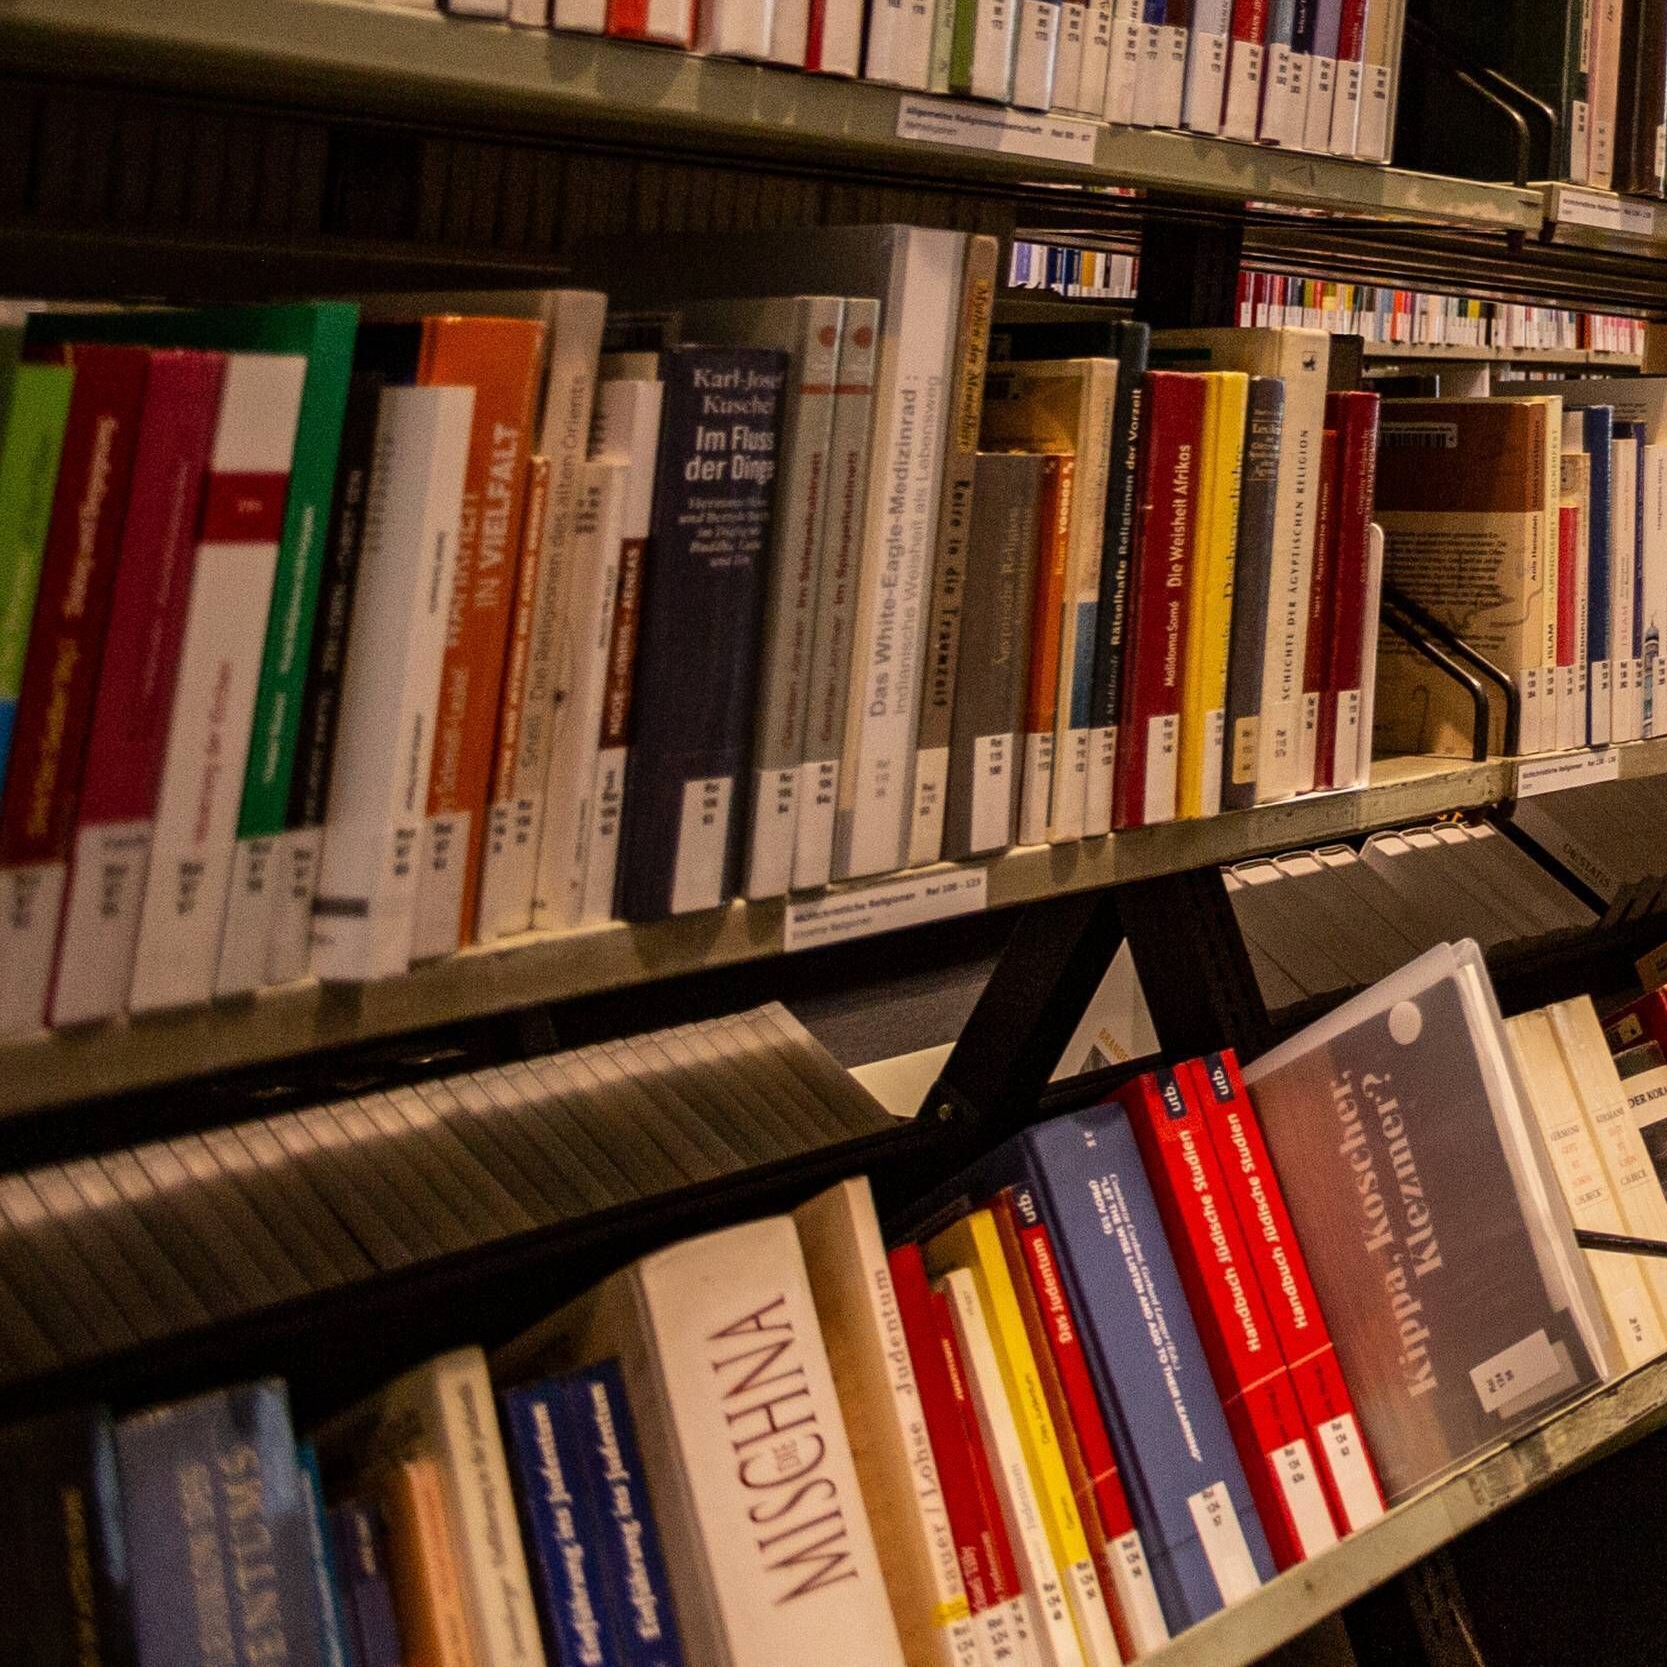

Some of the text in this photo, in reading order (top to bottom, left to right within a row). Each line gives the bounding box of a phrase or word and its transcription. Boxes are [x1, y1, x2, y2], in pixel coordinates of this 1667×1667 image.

[694, 421, 775, 453] Im Fluss
[915, 374, 941, 480] Lebensweg
[1128, 387, 1142, 439] Vorzeit
[682, 451, 775, 487] der Dinge
[1125, 444, 1137, 468] der
[1296, 429, 1310, 493] RELIGION
[912, 486, 927, 513] als
[1118, 473, 1135, 554] Religionen
[870, 387, 920, 717] Das White-Eagle-Medizinrad
[904, 518, 925, 601] Weisheit
[1163, 443, 1191, 687] Malidoma Somé Die Weisheit Afrikas
[1286, 500, 1304, 593] ÄGYPTISCHEN
[473, 574, 502, 610] IN
[932, 478, 971, 708] Reise in die Traumzeit
[1111, 559, 1127, 645] Rätselhafte
[1286, 600, 1297, 625] DER
[868, 888, 916, 909] Religionen
[1161, 1082, 1183, 1112] utb.
[1209, 1065, 1229, 1096] utb.
[1594, 1105, 1625, 1124] KERMANI
[1627, 1092, 1646, 1108] DER
[1358, 1068, 1446, 1277] Klezmer?
[1548, 1123, 1579, 1142] KERMANI
[1014, 1189, 1037, 1224] utb.
[1086, 1178, 1108, 1214] (PROV
[1223, 1112, 1311, 1329] Handbuch Jüdische Studien
[1320, 1068, 1442, 1398] Kippa, Koscher,
[1176, 1129, 1262, 1353] Handbuch Jüdische Studien
[1027, 1236, 1073, 1344] Das Judentum
[874, 1267, 911, 1396] Judentum
[1106, 1202, 1122, 1224] THE
[1114, 1225, 1132, 1254] WISE
[1123, 1255, 1145, 1293] LISTEN
[1137, 1294, 1154, 1320] AND
[1146, 1319, 1163, 1346] ADD
[1160, 1364, 1180, 1398] THEIR
[1171, 1398, 1204, 1462] LEARNING"
[527, 1399, 572, 1506] Judentum
[584, 1380, 629, 1482] Judentum
[705, 1293, 860, 1608] MISCHNA
[771, 1437, 802, 1472] DIE
[905, 1421, 937, 1497] Lohse
[555, 1542, 608, 1667] Einführung
[615, 1519, 666, 1641] Einführung
